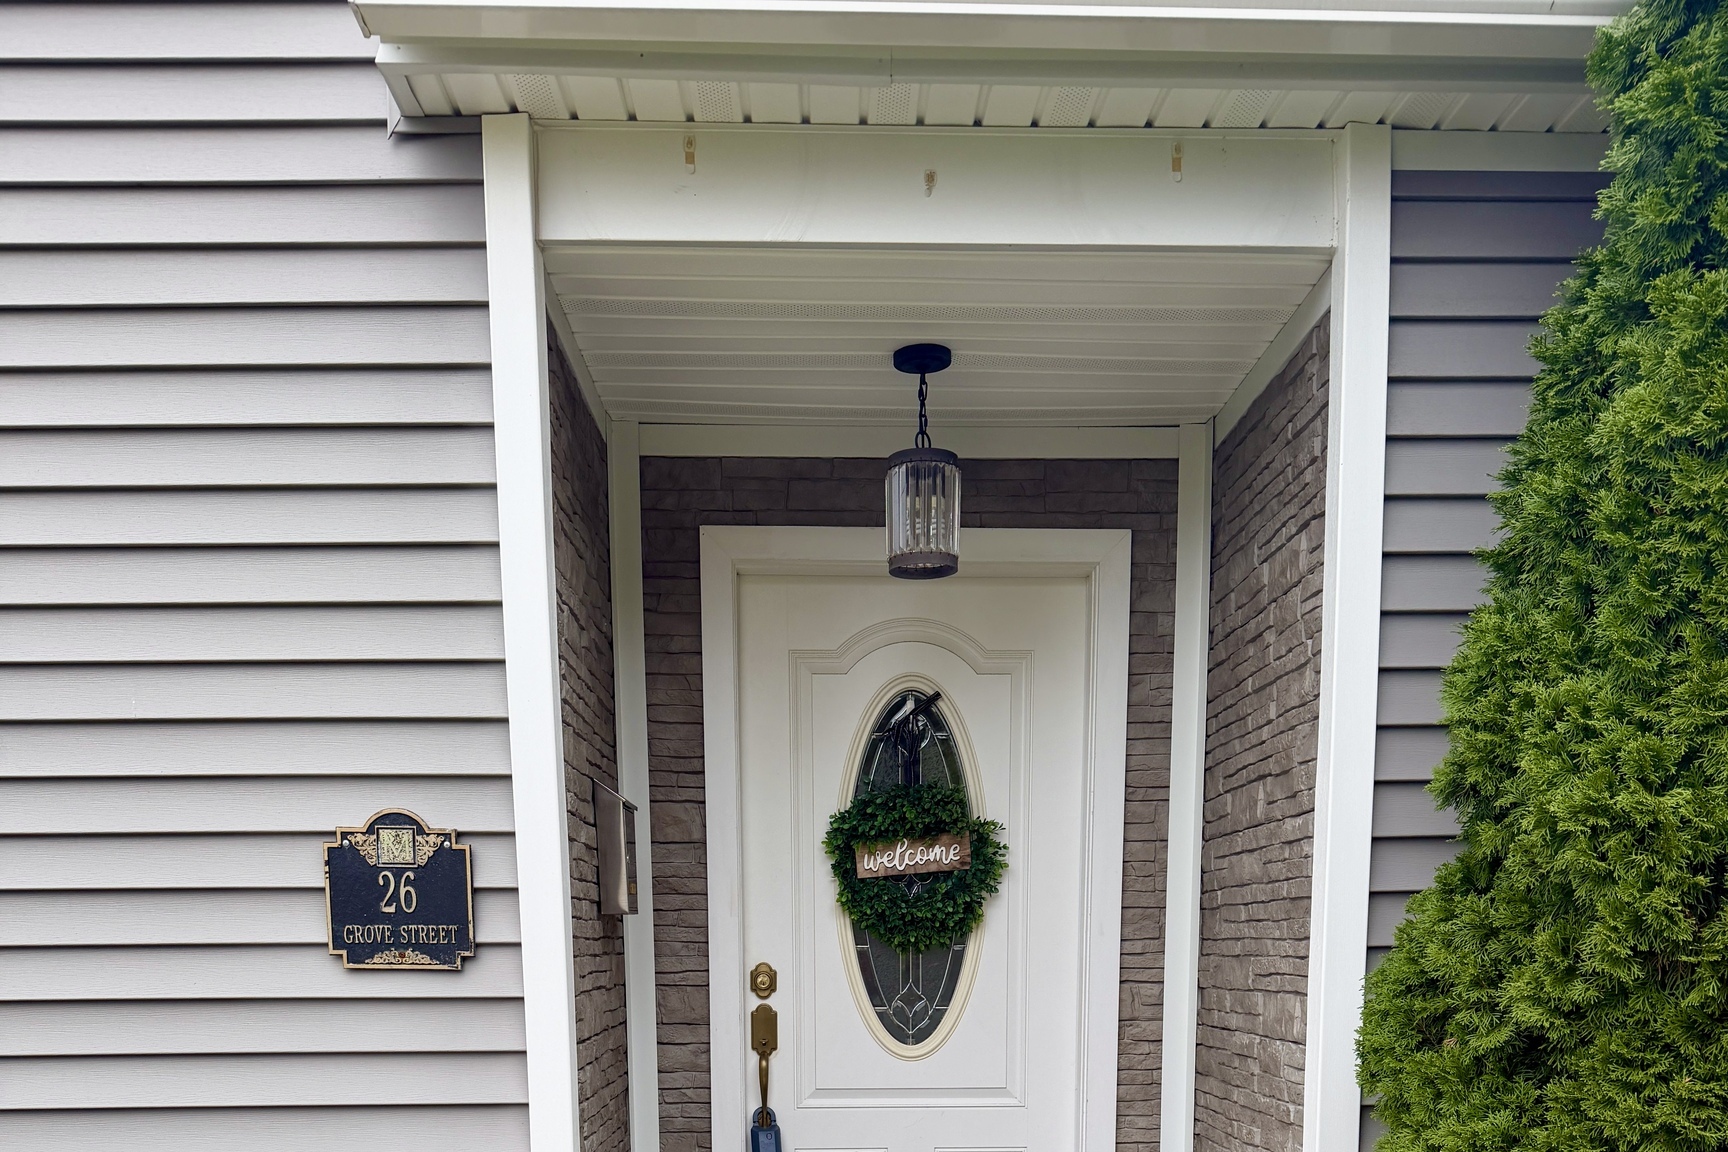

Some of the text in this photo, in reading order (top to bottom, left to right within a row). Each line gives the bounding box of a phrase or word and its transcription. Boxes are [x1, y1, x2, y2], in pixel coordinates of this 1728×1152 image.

[863, 838, 961, 872] welcome
[378, 871, 417, 914] 26
[343, 924, 458, 944] GROVE STREET
